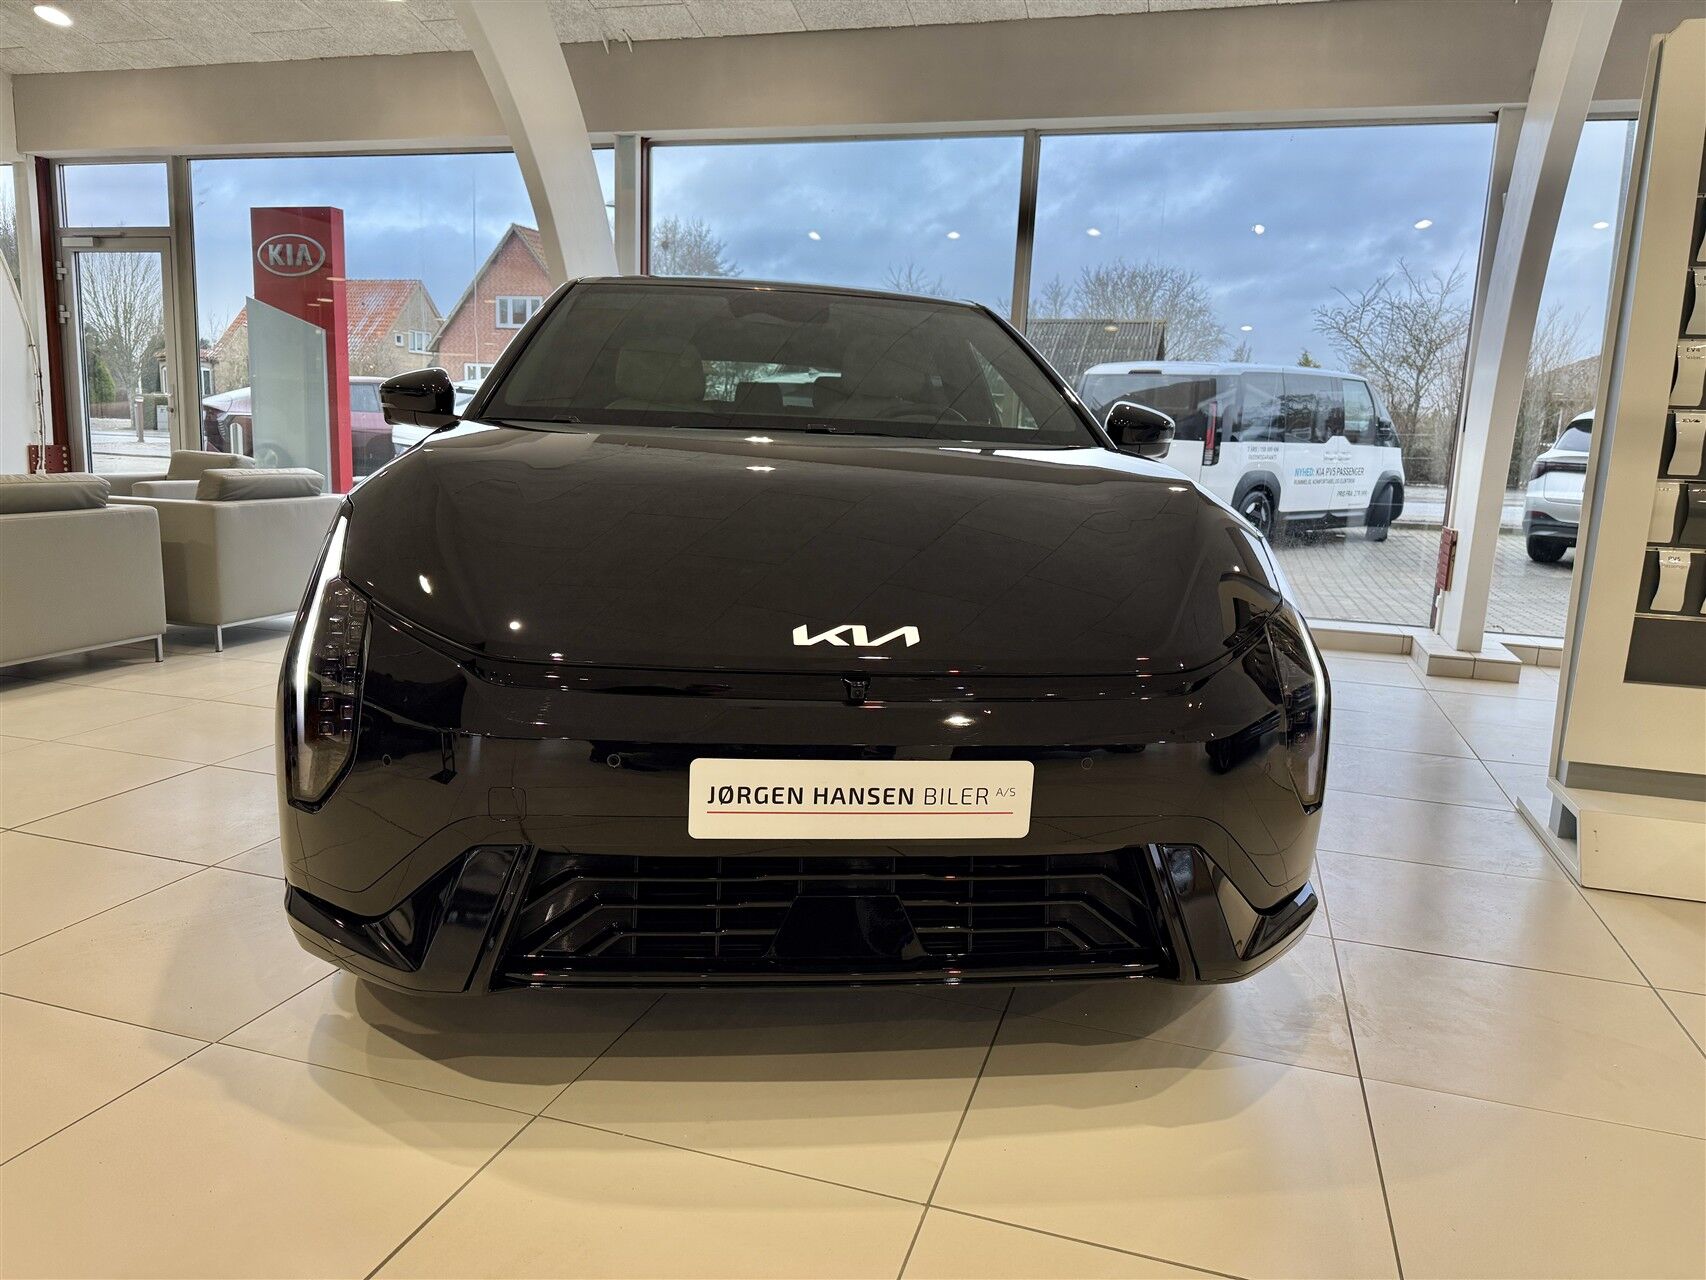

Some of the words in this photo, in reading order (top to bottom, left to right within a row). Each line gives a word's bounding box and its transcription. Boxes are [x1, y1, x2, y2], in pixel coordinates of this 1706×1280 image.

[268, 243, 313, 266] KIA
[1316, 467, 1325, 476] KIA
[1336, 467, 1365, 476] PASSENGER
[707, 785, 804, 806] JØRGEN
[813, 786, 915, 806] HANSEN
[923, 787, 990, 806] BILER
[995, 786, 1017, 798] A/S
